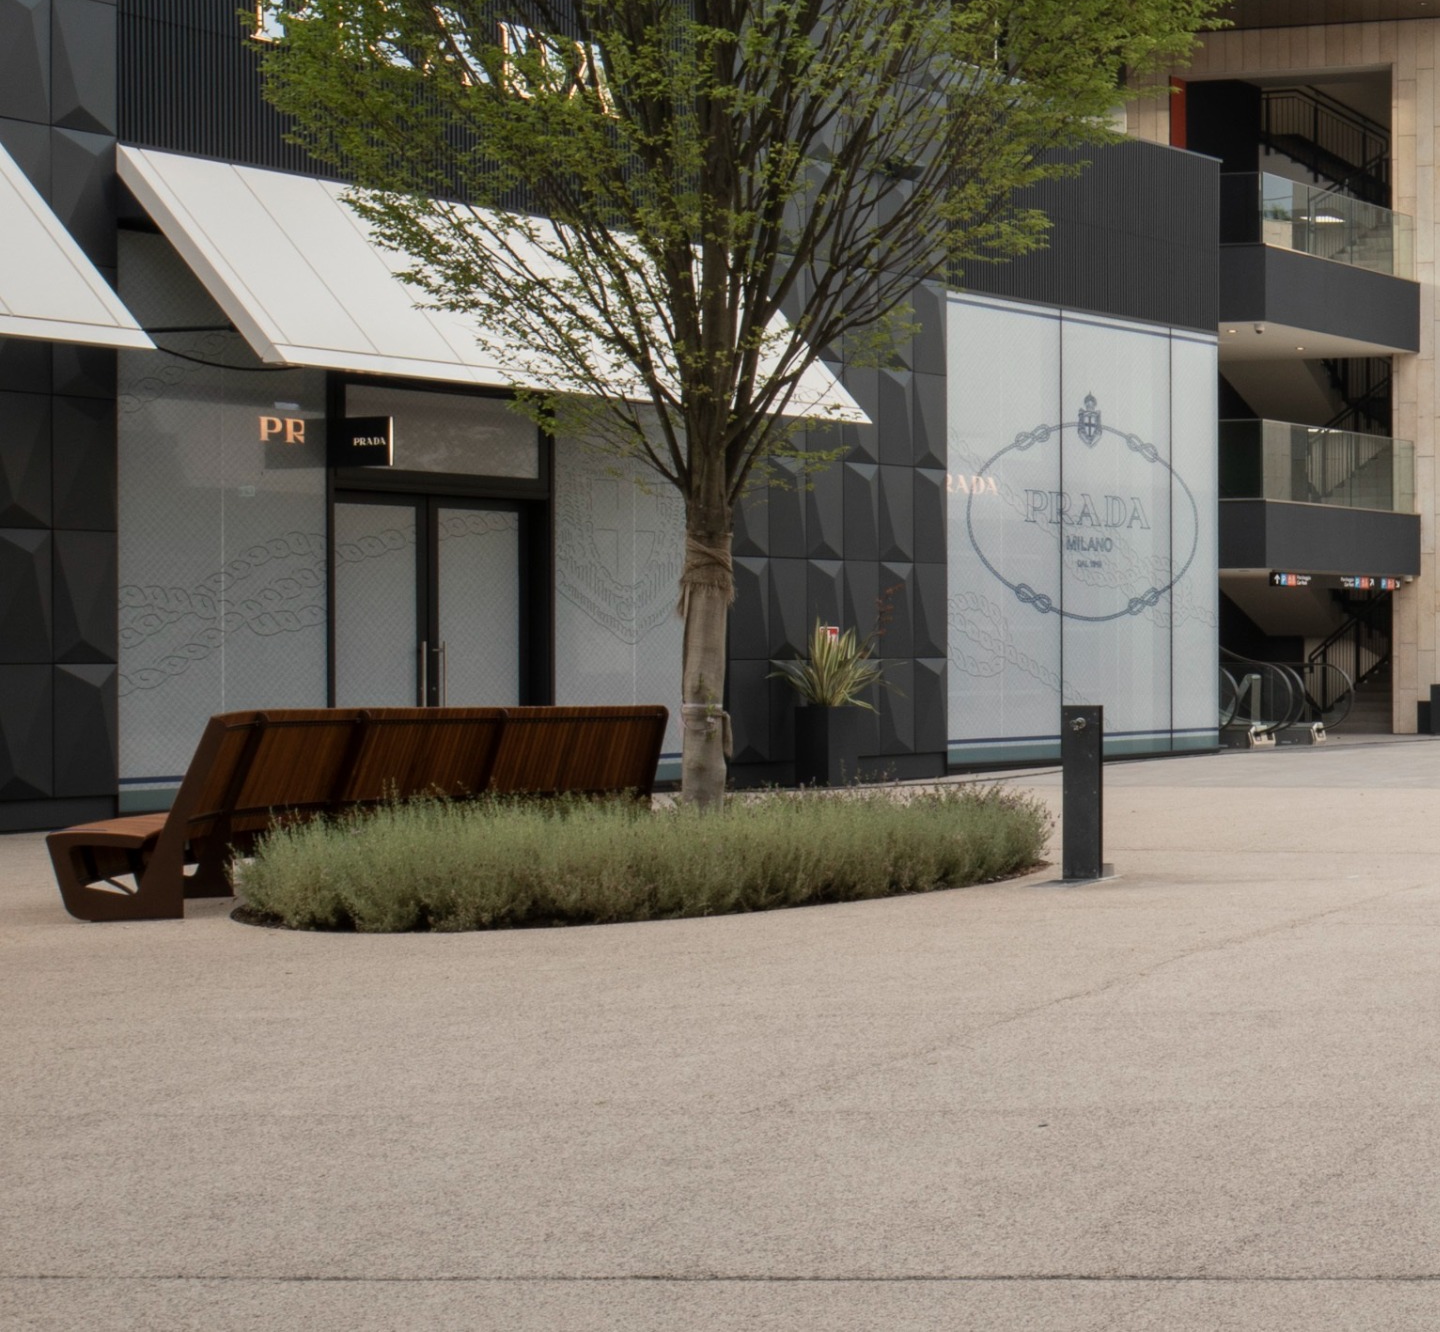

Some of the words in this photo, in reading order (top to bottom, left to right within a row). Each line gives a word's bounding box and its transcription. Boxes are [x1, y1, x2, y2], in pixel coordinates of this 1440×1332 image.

[259, 416, 305, 444] PR
[353, 437, 387, 447] PRADA
[1024, 489, 1151, 530] PRADA
[1066, 535, 1113, 553] MILANO
